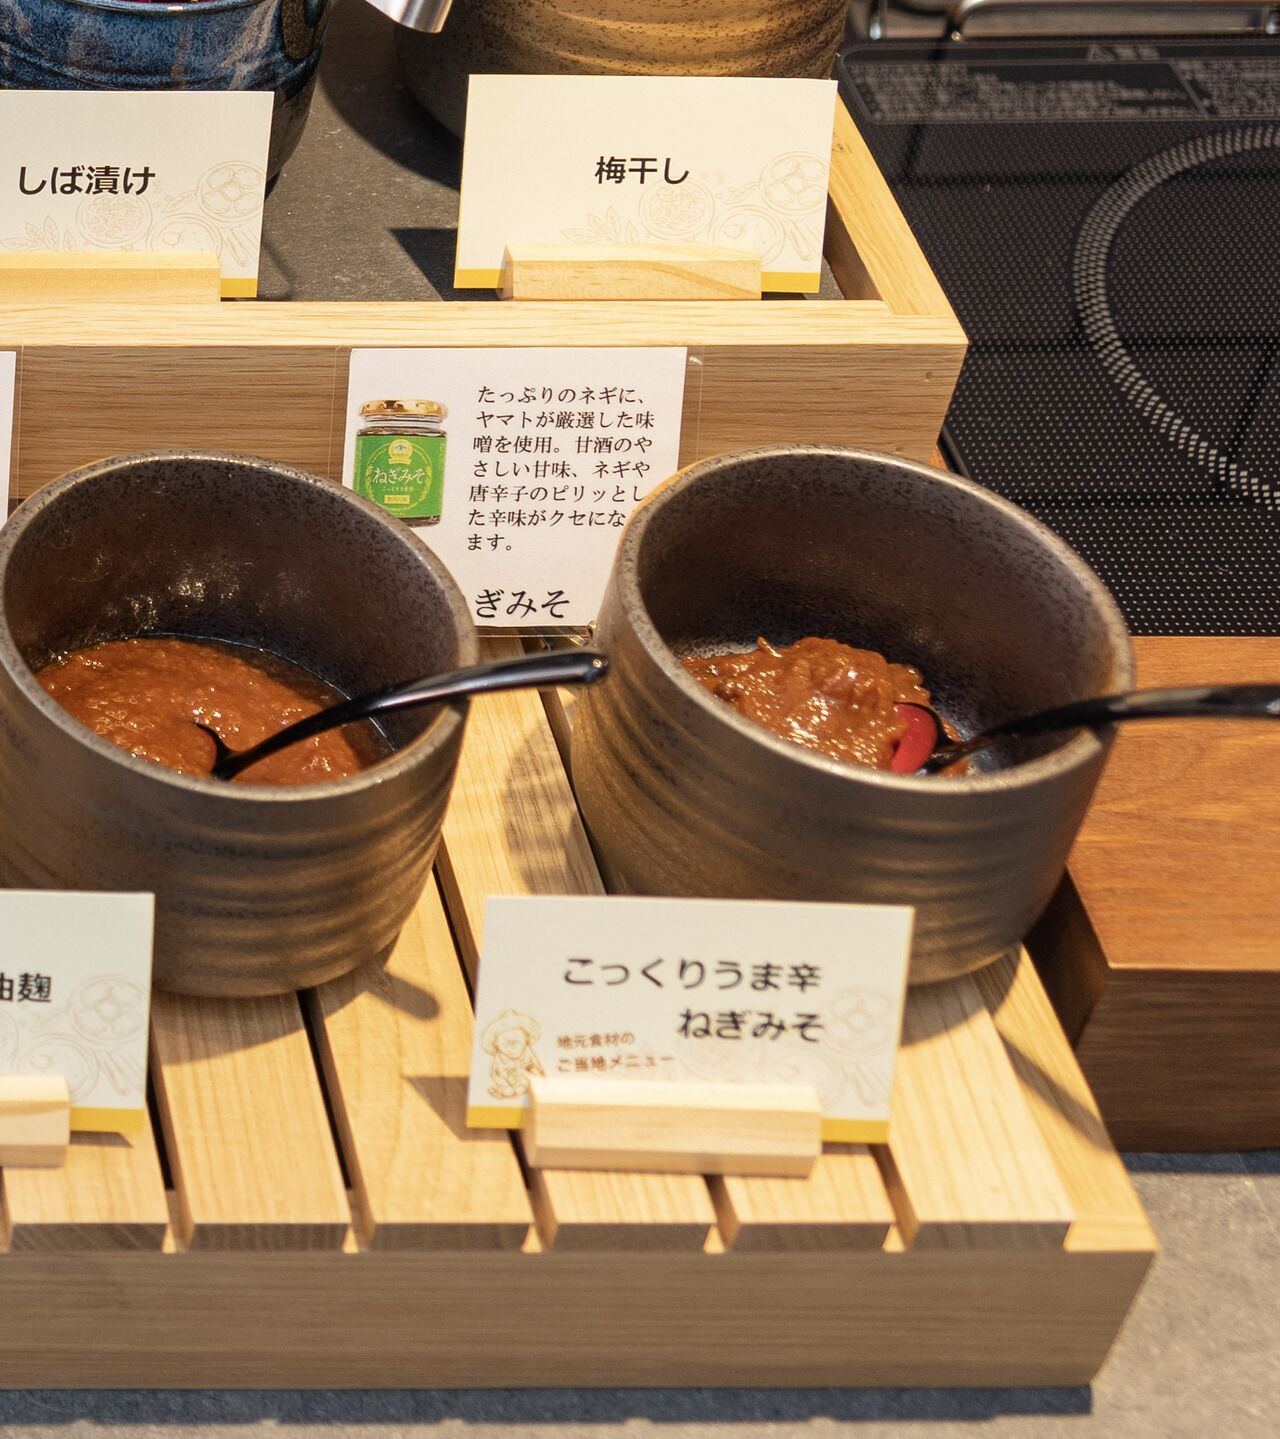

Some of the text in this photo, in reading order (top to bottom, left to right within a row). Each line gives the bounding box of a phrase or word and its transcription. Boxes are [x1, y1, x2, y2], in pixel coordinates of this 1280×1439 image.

[594, 155, 690, 185] 梅干し
[17, 166, 156, 197] しば漬け
[478, 386, 646, 404] たっぷりのネギに、
[476, 411, 654, 429] ヤマトが厳選した味
[473, 436, 652, 454] 噌を使用。甘酒のや
[373, 467, 424, 485] ねぎみそ
[473, 461, 650, 478] さしい甘味、ネギや
[469, 509, 625, 527] た辛味がクセにな
[467, 534, 512, 551] ます。
[475, 589, 569, 619] ぎみそ
[564, 958, 823, 992] こっくりうま辛
[678, 1009, 824, 1043] ねぎみそ
[557, 1032, 634, 1048] 地元食材の
[557, 1054, 675, 1073] ご当地メニュー
